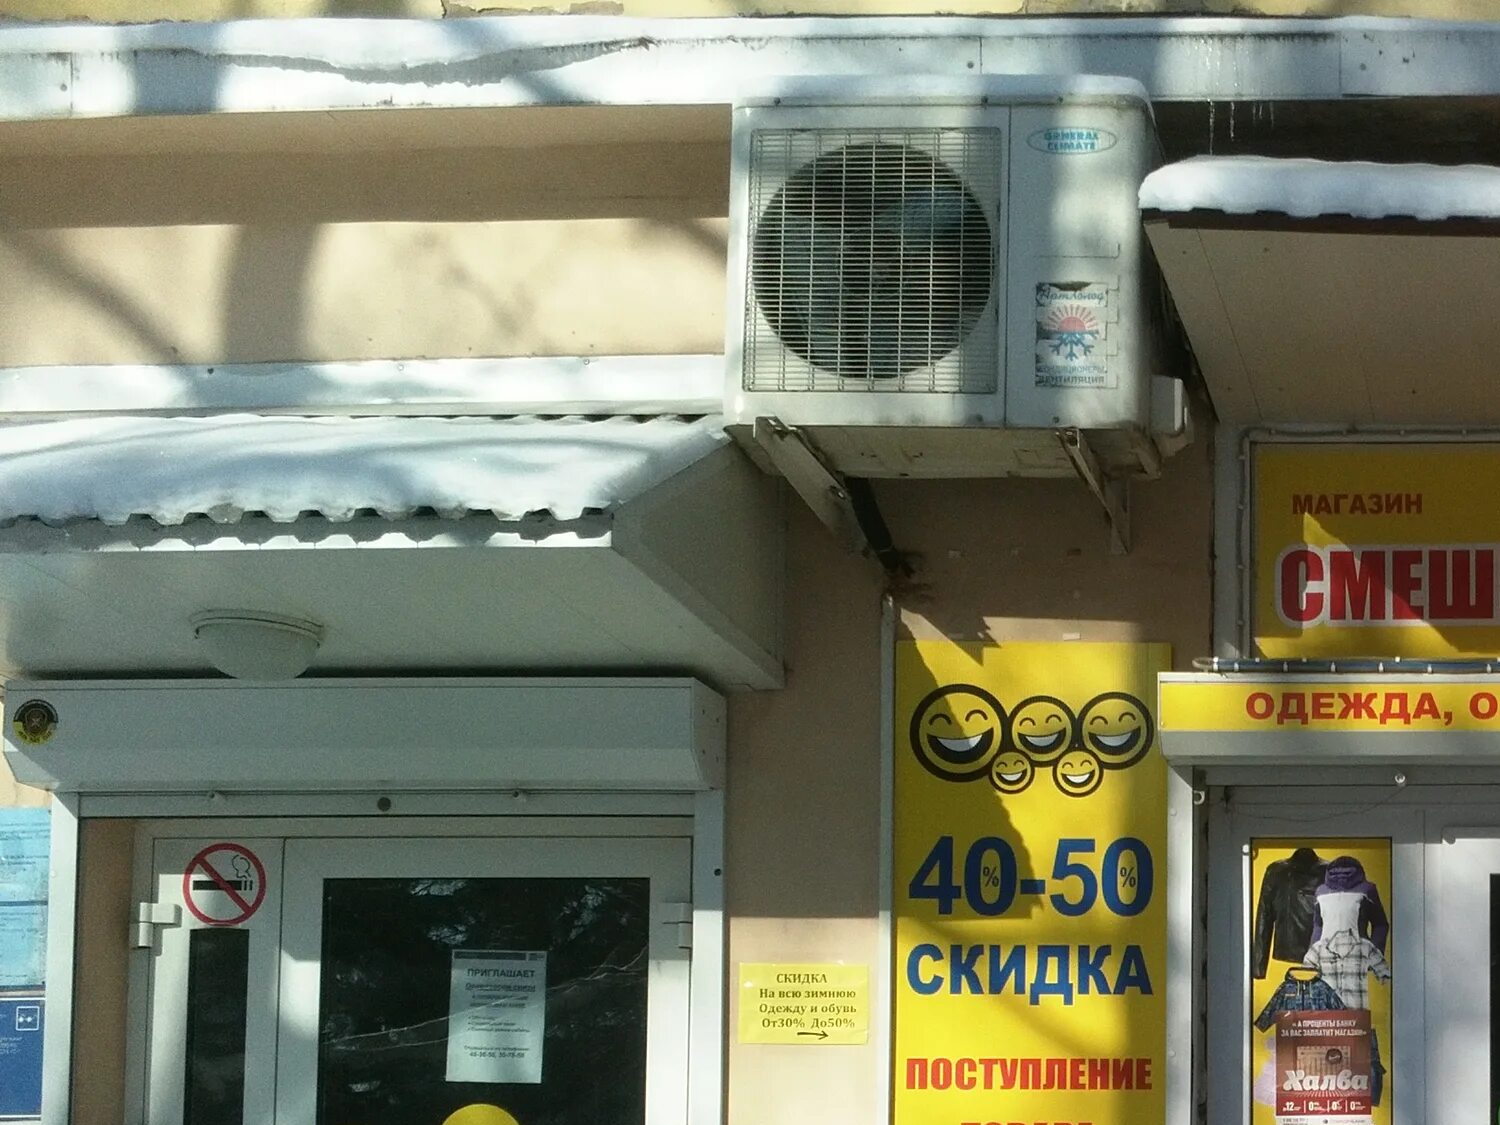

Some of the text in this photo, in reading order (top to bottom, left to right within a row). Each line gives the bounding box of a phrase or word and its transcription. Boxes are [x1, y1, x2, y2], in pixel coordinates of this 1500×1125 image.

[1291, 493, 1423, 515] МАГАЗИН
[1245, 691, 1454, 726] ОДЕЖДА,
[467, 968, 536, 979] ПРИГЛАШАЕТ
[776, 973, 828, 985] СКИДКА
[906, 943, 1154, 1006] СКИДКА
[759, 988, 857, 999] На всю зимнюю
[759, 1002, 858, 1016] Одежду и обувь
[905, 1057, 1153, 1091] ПОСТУПЛЕНИЕ
[1283, 1069, 1369, 1091] Халва
